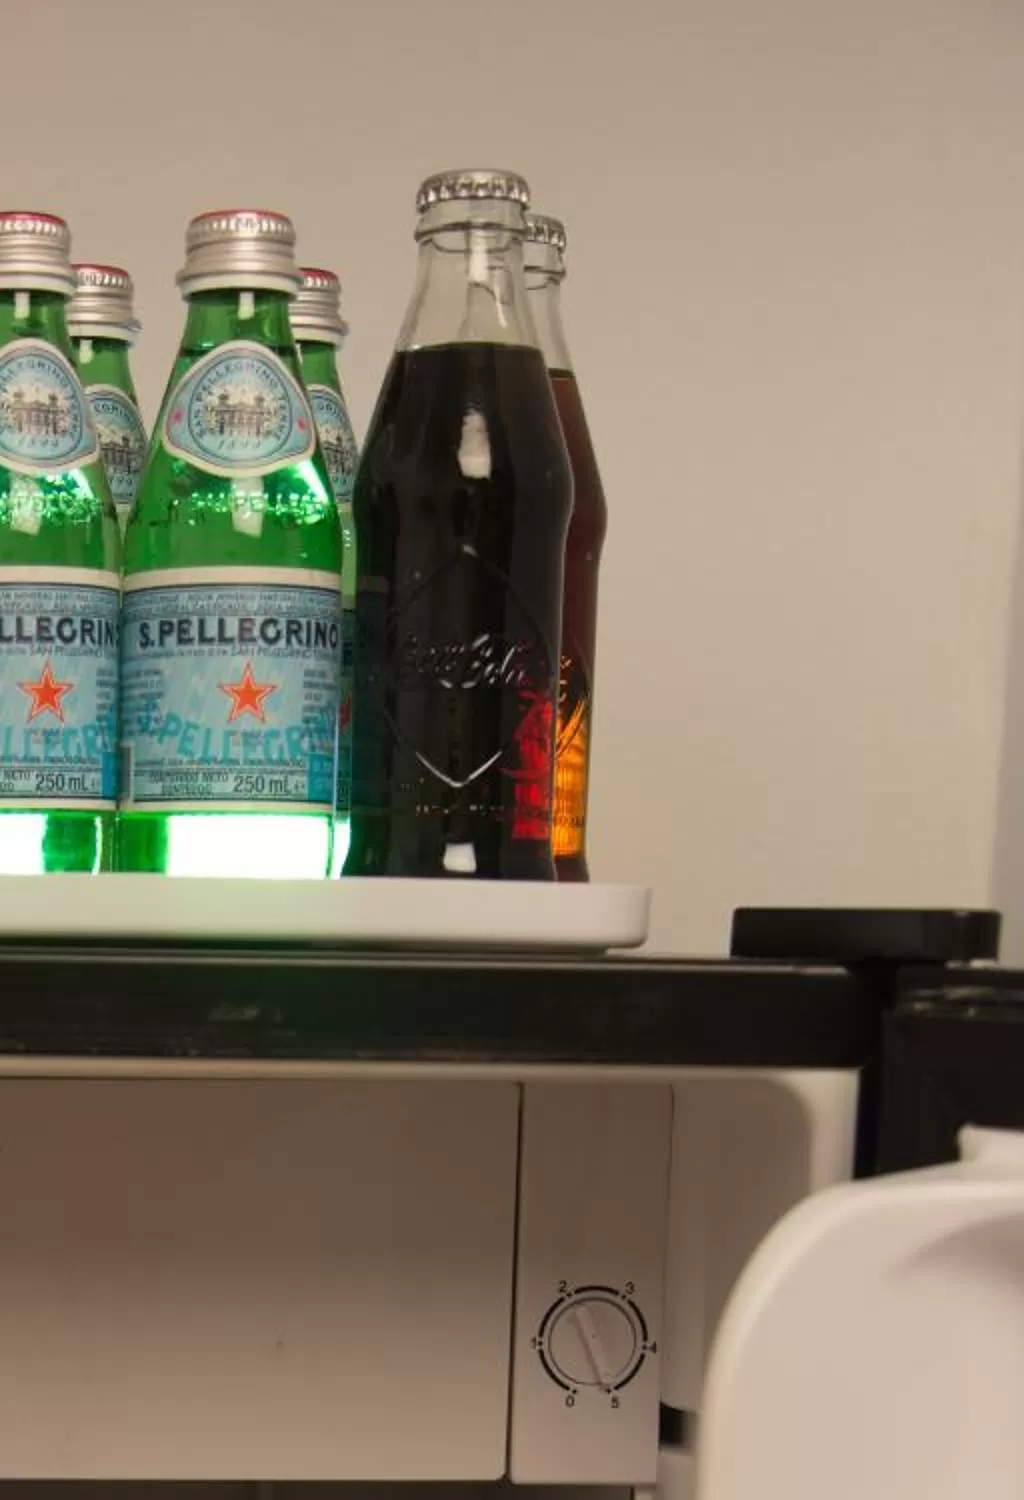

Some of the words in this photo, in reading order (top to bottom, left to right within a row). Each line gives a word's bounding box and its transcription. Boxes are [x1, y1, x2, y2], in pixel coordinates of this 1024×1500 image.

[138, 616, 340, 649] S.PELLEGRINO
[35, 773, 65, 791] 250
[68, 775, 89, 791] mL
[232, 775, 265, 794] 250
[268, 775, 291, 793] mL
[559, 1280, 567, 1293] 2
